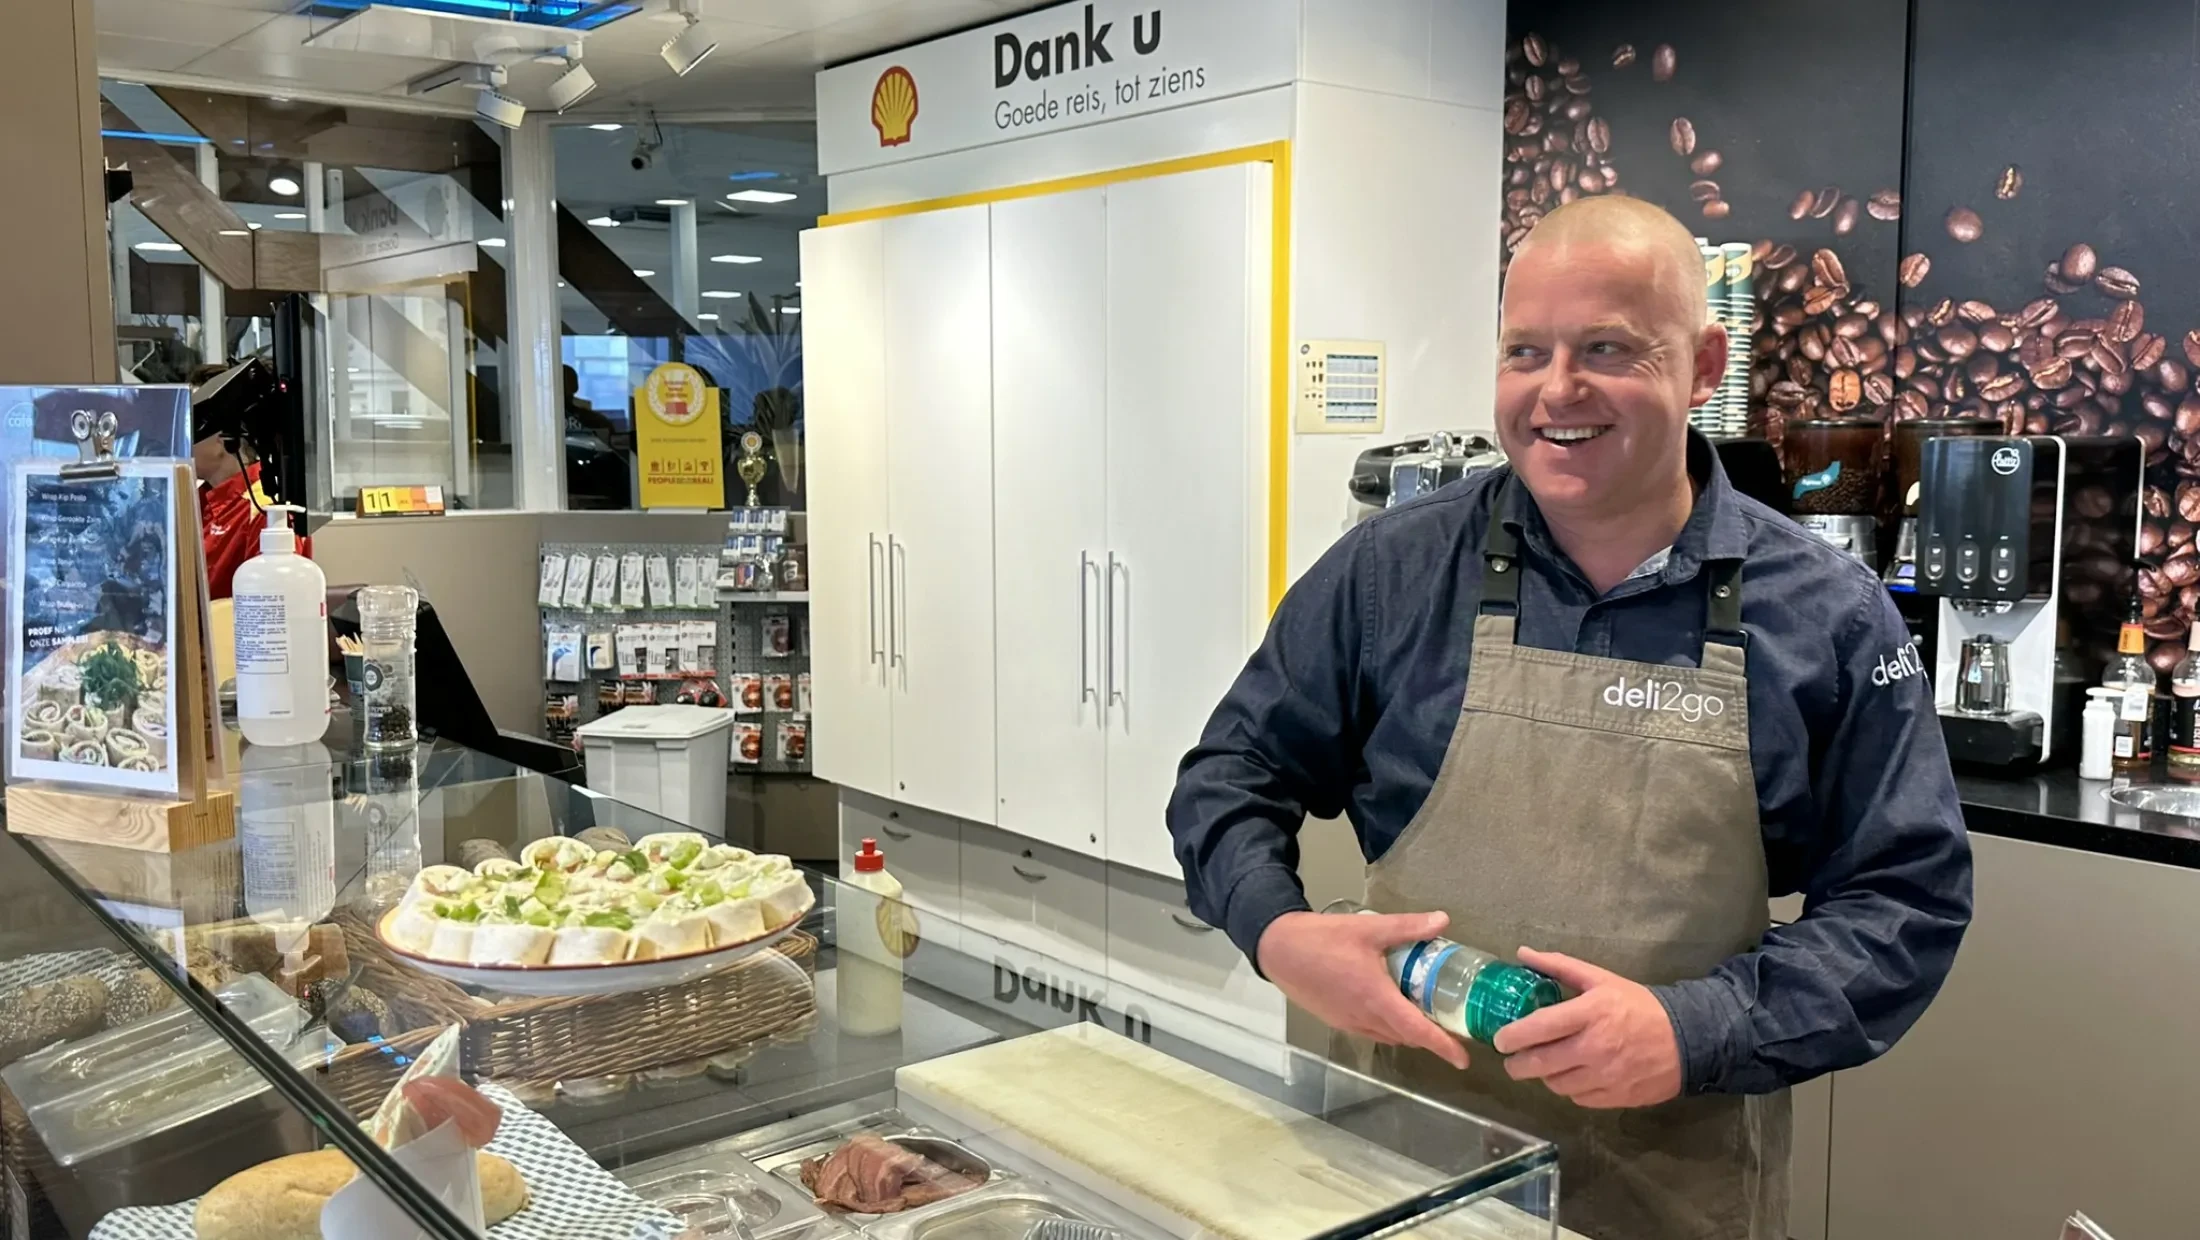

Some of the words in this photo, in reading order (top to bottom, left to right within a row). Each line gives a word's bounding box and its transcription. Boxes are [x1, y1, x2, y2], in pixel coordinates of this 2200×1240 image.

[994, 4, 1114, 90] Dank
[1133, 9, 1162, 55] u
[994, 90, 1059, 130] Goede
[1066, 84, 1106, 115] reis,
[1115, 74, 1141, 105] tot
[1148, 64, 1206, 99] ziens
[28, 625, 53, 637] PROEF
[29, 637, 51, 648] ONZE
[1871, 642, 1928, 687] deli2
[1603, 676, 1725, 723] deli2go
